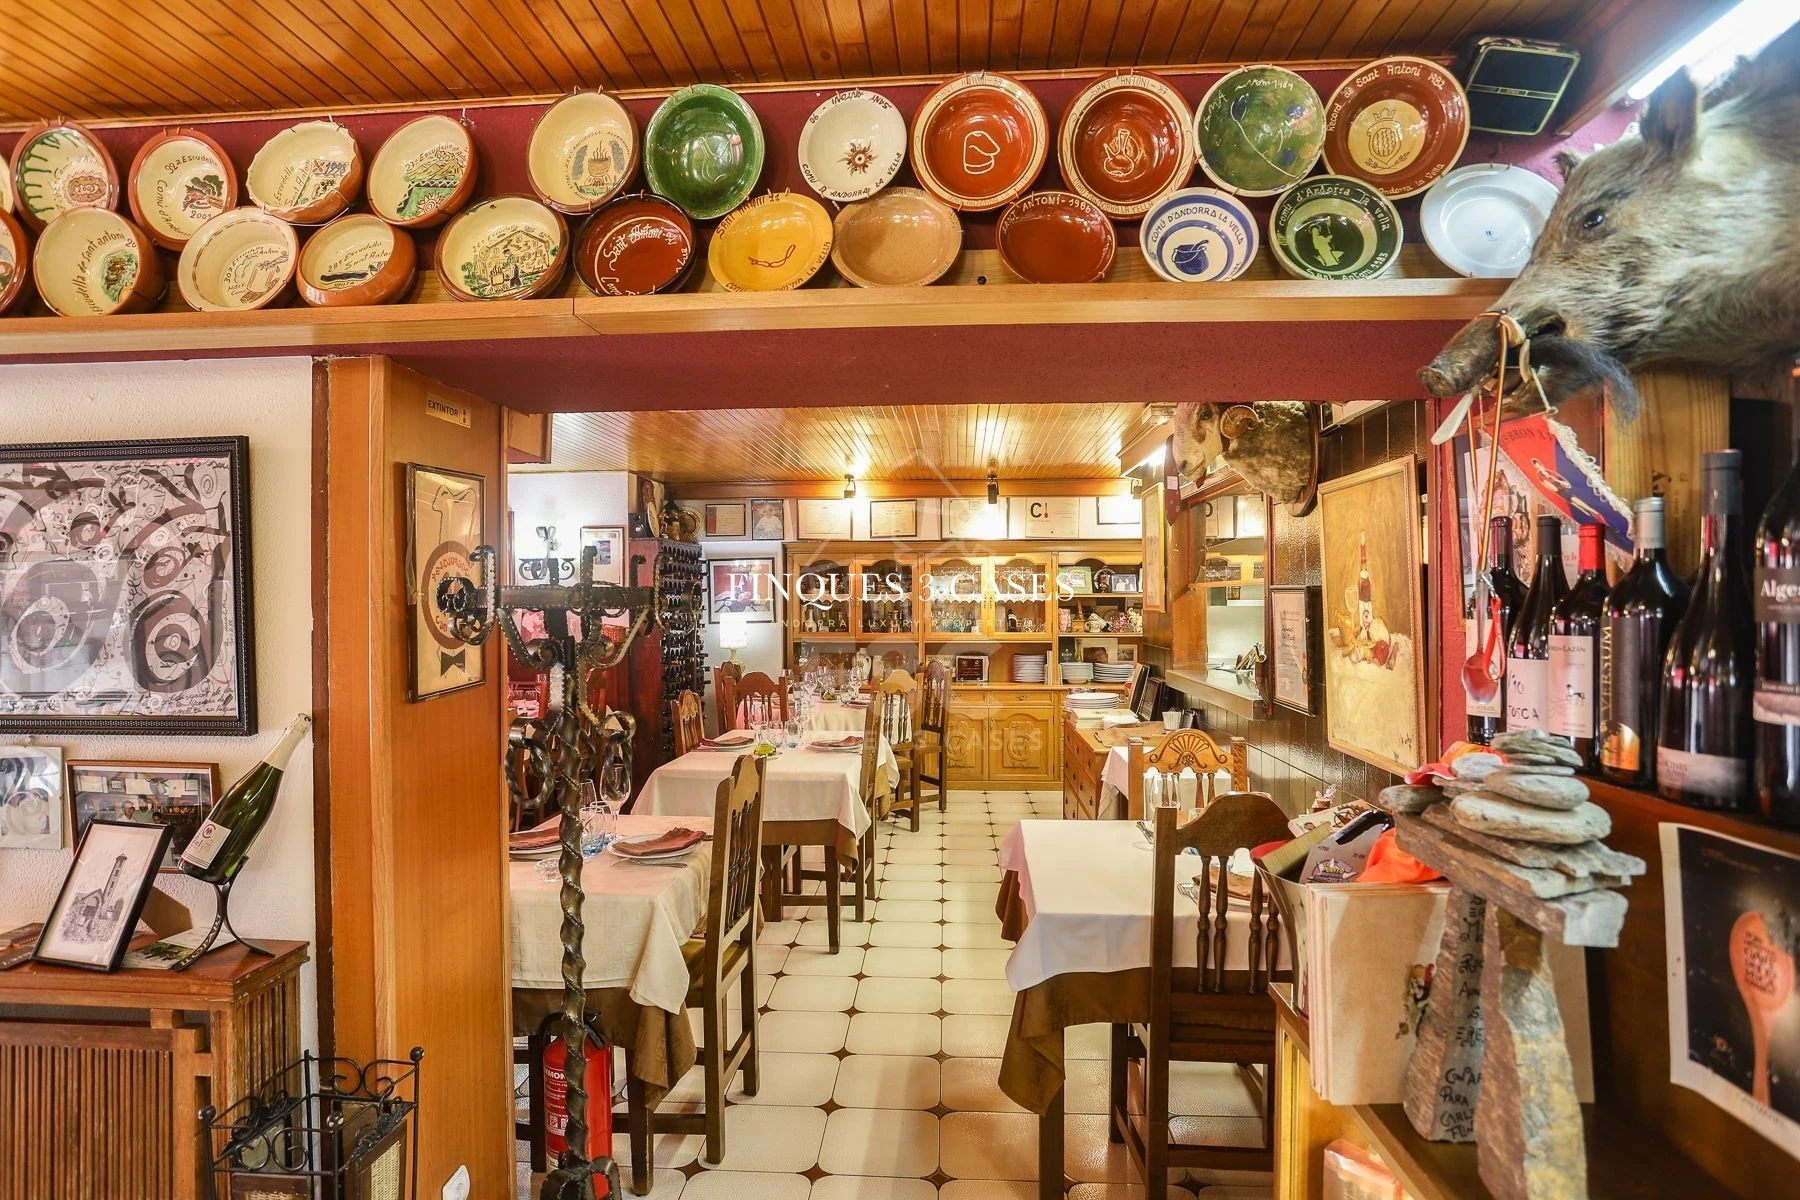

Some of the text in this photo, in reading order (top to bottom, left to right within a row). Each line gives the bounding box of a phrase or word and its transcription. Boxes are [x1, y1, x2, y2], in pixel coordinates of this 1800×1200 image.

[1386, 64, 1423, 77] Antoni
[1151, 206, 1245, 245] COMÚ D'ANDORRA LA VELLA
[427, 399, 459, 417] EXTINTOR
